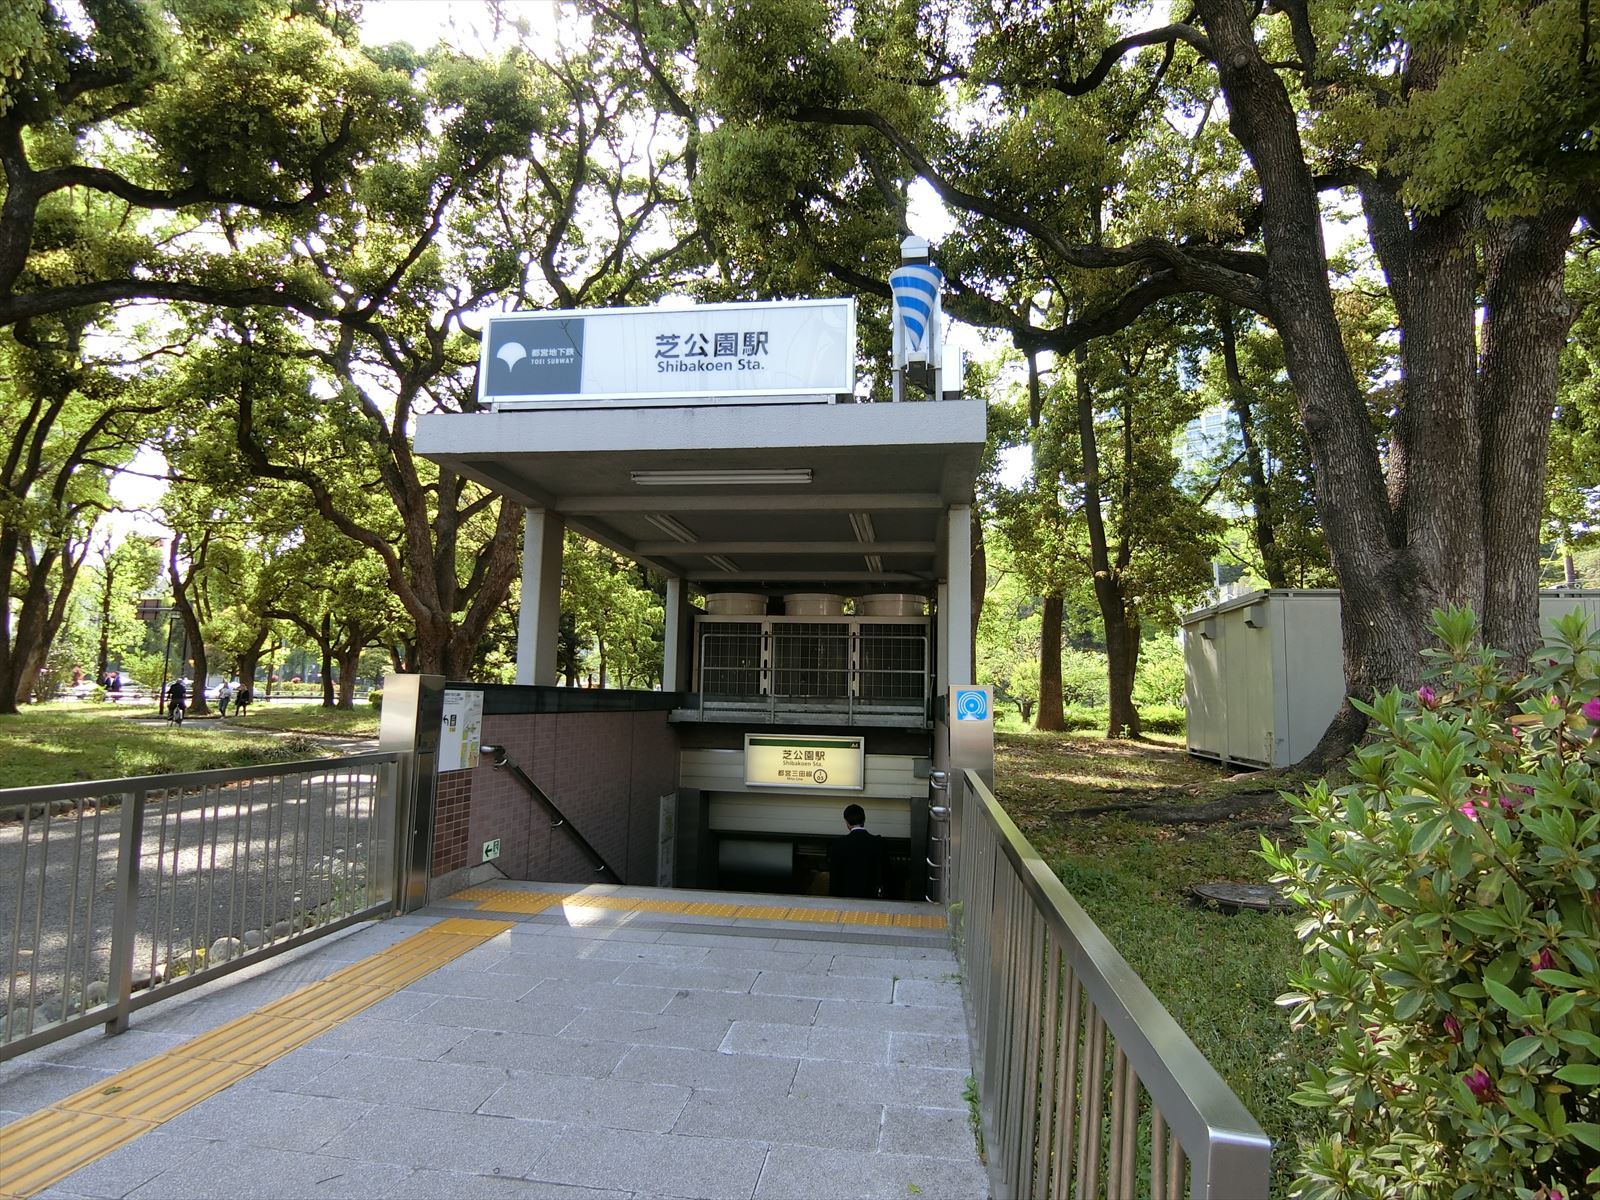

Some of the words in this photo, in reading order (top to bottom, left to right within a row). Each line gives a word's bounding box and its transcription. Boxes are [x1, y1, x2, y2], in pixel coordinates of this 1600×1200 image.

[654, 331, 769, 358] 芝公園駅
[547, 357, 575, 365] SUBWAY
[657, 360, 733, 373] Shibakoen
[738, 358, 765, 371] Sta.
[782, 750, 825, 761] 芝公園駅
